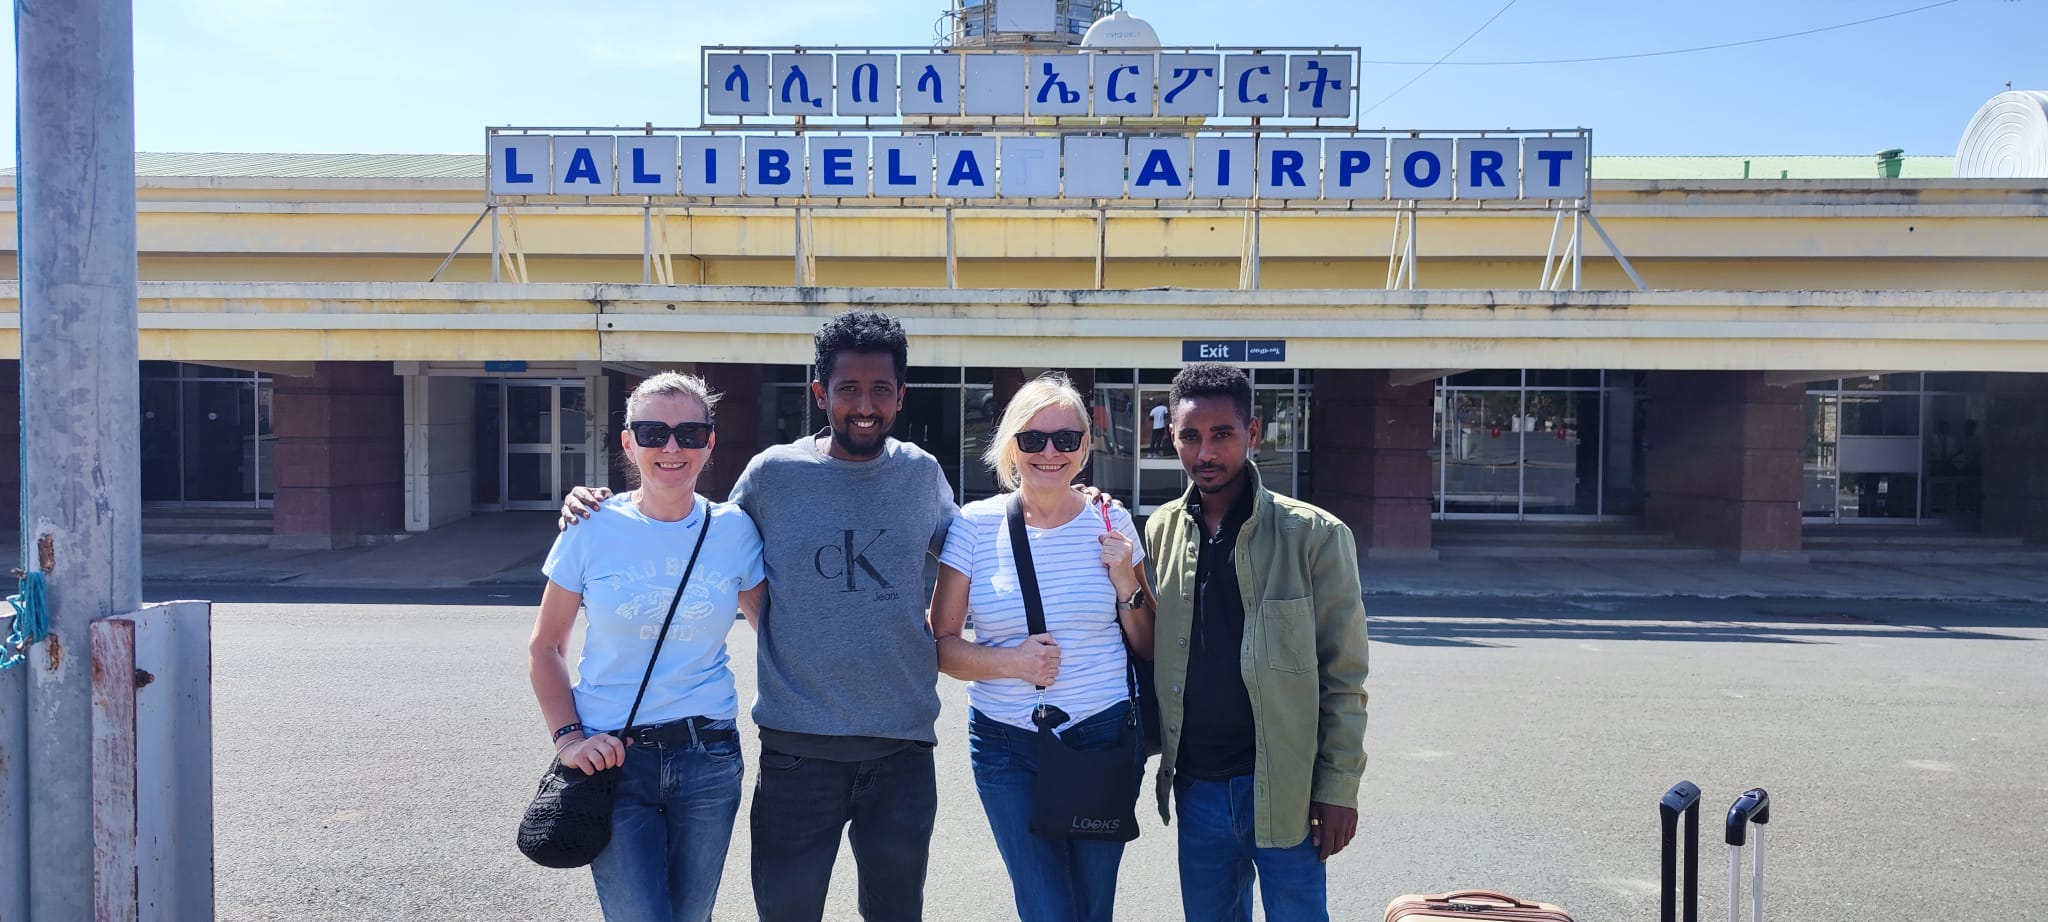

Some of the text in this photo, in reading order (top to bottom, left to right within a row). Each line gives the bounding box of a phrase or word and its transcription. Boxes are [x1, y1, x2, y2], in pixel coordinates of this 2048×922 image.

[724, 60, 1342, 108] ላሊበላ ኤርፖርት
[505, 147, 1573, 188] LALIBELA AIRPORT
[1200, 344, 1229, 358] Exit
[873, 591, 900, 602] Jeans
[1072, 815, 1121, 829] LOOKS
